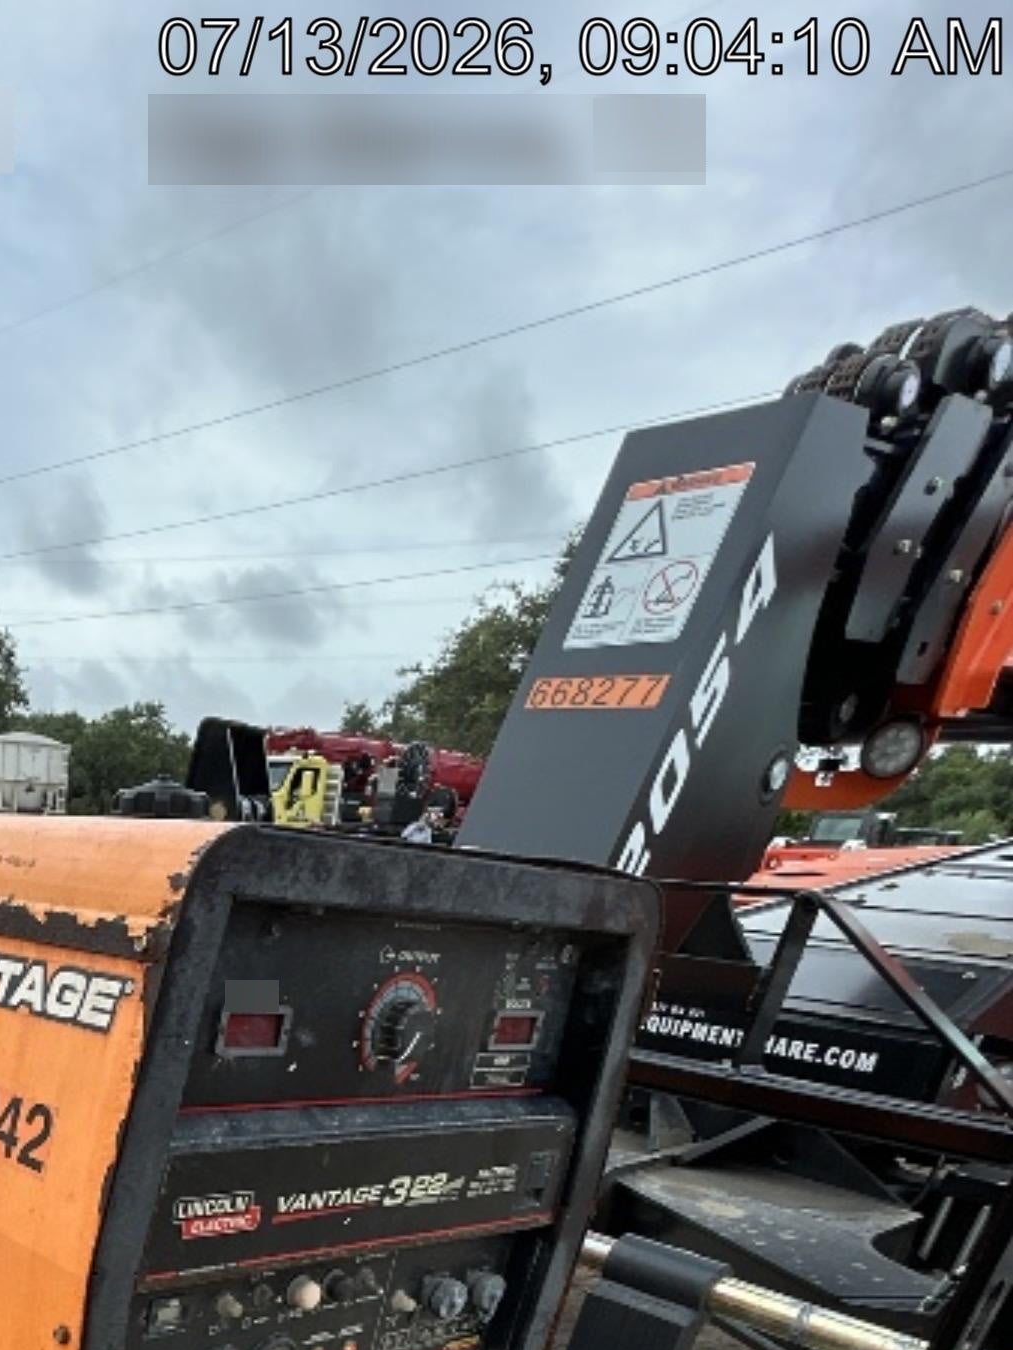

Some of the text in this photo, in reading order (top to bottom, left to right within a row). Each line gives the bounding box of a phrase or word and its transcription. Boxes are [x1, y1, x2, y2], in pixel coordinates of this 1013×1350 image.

[530, 676, 663, 708] 668277
[178, 1196, 250, 1219] LINCOLN
[277, 1183, 386, 1214] VANTAGE
